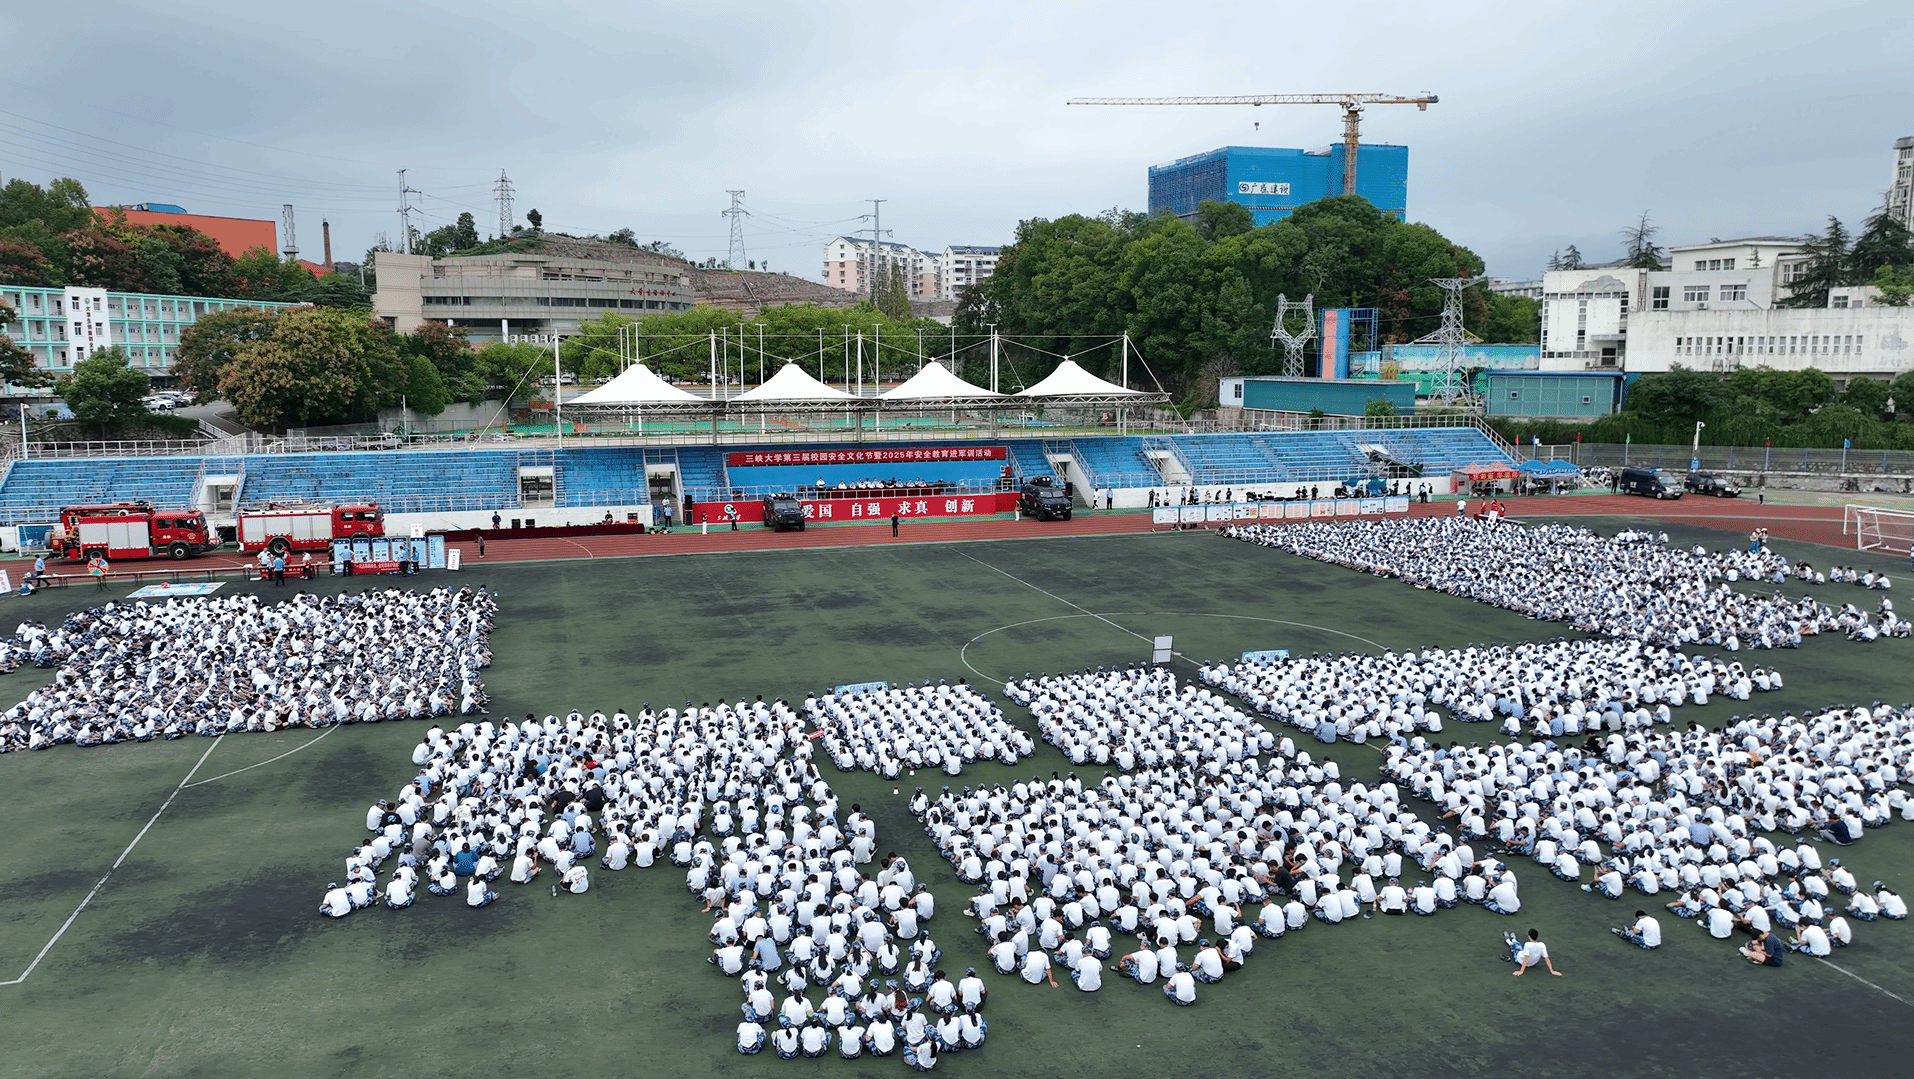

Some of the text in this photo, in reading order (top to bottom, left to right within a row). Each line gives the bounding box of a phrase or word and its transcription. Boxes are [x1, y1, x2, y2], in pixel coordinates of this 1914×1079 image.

[745, 449, 992, 463] 三峡大学第三届校园安全文化节暨2025年安全教育进军训活动
[801, 499, 975, 519] 爱国 自强 求真 创新
